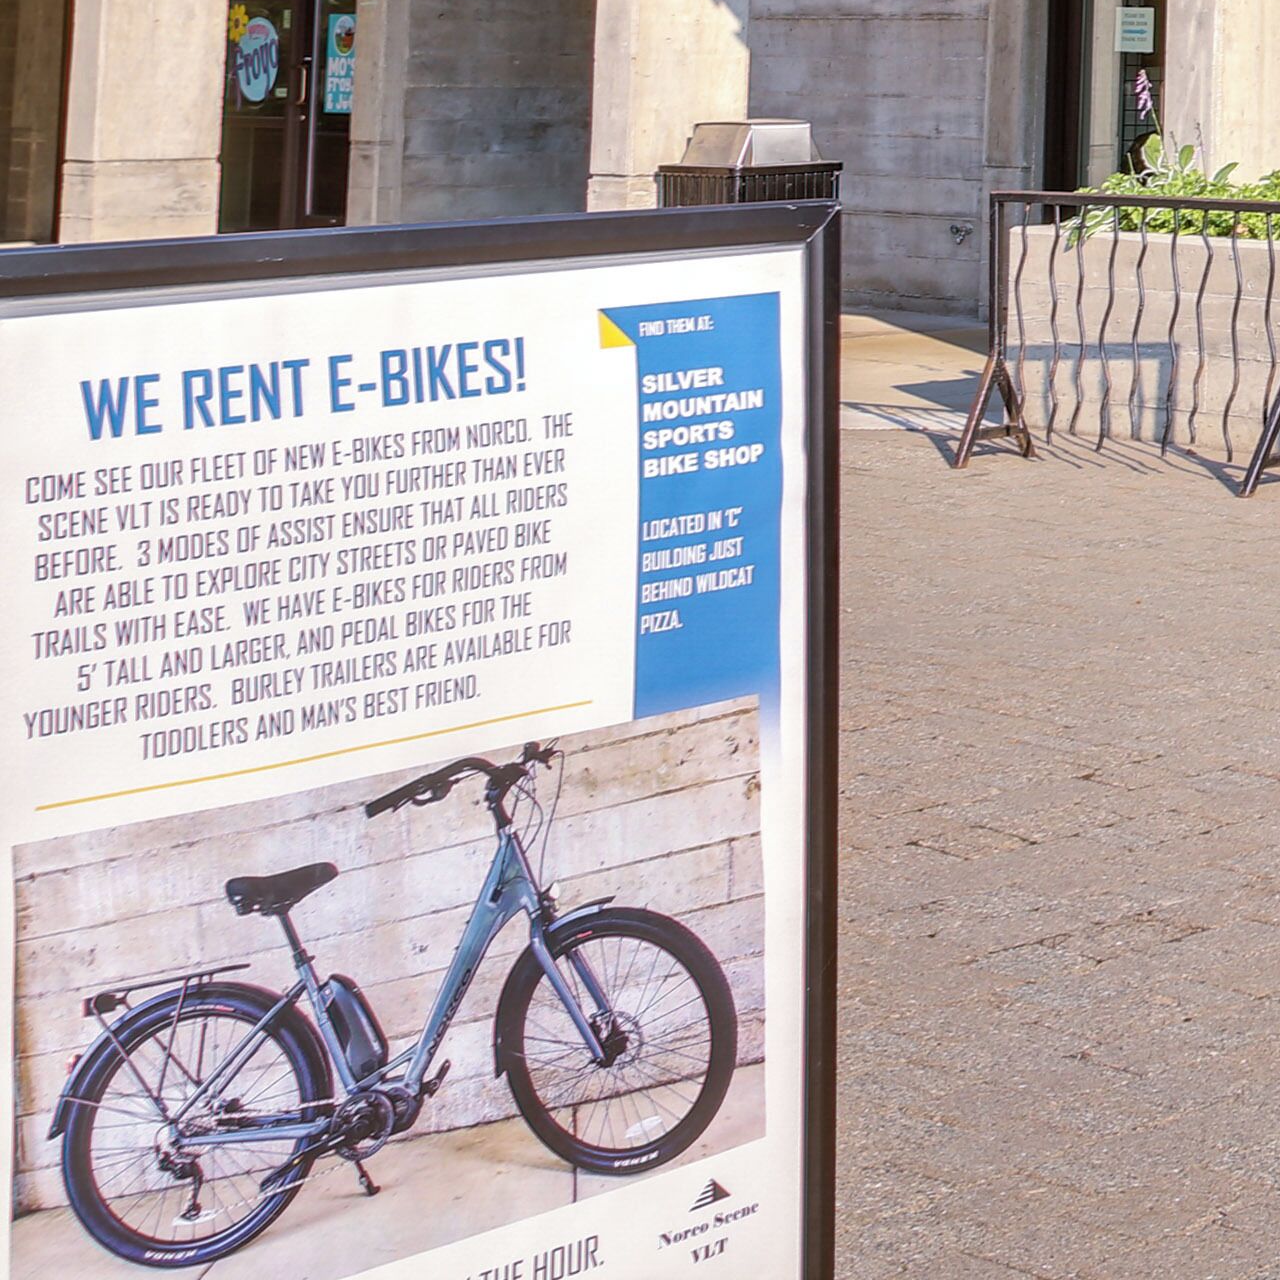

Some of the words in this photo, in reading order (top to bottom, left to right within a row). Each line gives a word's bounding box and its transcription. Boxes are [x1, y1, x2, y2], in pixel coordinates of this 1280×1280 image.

[639, 320, 664, 337] FIND
[666, 317, 696, 334] THEM
[696, 315, 715, 331] AT:
[79, 373, 163, 441] WE
[181, 358, 310, 430] RENT
[328, 336, 526, 413] E-BIKES!
[642, 366, 725, 394] SILVER
[643, 389, 764, 422] MOUNTAIN
[642, 421, 736, 450] SPORTS
[25, 470, 87, 505] COME
[94, 465, 133, 497] SEE
[139, 459, 183, 491] OUR
[190, 451, 247, 484] FLEET
[253, 447, 278, 477] OF
[284, 442, 326, 473] NEW
[331, 432, 405, 467] E-BIKES
[411, 426, 461, 457] FROM
[465, 418, 532, 450] NORCO.
[541, 412, 574, 440] THE
[643, 452, 699, 478] BIKE
[703, 443, 765, 469] SHOP
[38, 506, 109, 543] SCENE
[115, 501, 153, 532] VLT
[159, 497, 180, 526] IS
[186, 488, 252, 523] READY
[257, 484, 283, 513] TO
[288, 477, 335, 509] TAKE
[340, 472, 380, 502] YOU
[385, 460, 467, 496] FURTHER
[471, 454, 518, 484] THAN
[523, 448, 565, 477] EVER
[34, 544, 123, 582] BEFORE.
[137, 539, 151, 568] 3
[157, 529, 230, 565] MODES
[236, 524, 261, 554] OF
[266, 513, 336, 550] ASSIST
[342, 503, 414, 539] ENSURE
[419, 496, 465, 527] THAT
[469, 492, 501, 520] ALL
[506, 482, 568, 515] RIDERS
[642, 513, 705, 541] LOCATED
[708, 510, 723, 531] IN
[53, 585, 96, 619] ARE
[102, 577, 155, 611] ABLE
[161, 572, 188, 602] TO
[195, 558, 282, 598] EXPLORE
[288, 551, 331, 583] CITY
[336, 539, 417, 576] STREETS
[422, 534, 447, 563] OR
[452, 525, 509, 558] PAVED
[514, 519, 552, 549] BIKE
[642, 544, 707, 572] BUILDING
[709, 537, 744, 561] JUST
[31, 622, 107, 660] TRAILS
[114, 613, 166, 647] WITH
[174, 605, 231, 639] EASE.
[242, 597, 271, 627] WE
[277, 588, 326, 622] HAVE
[332, 577, 406, 613] E-BIKES
[412, 570, 447, 601] FOR
[452, 559, 515, 594] RIDERS
[520, 551, 567, 582] FROM
[641, 576, 693, 604] BEHIND
[696, 565, 755, 594] WILDCAT
[77, 663, 97, 693] 5'
[103, 655, 153, 688] TALL
[159, 646, 203, 679] AND
[210, 632, 291, 671] LARGER,
[296, 624, 335, 657] AND
[341, 614, 400, 648] PEDAL
[405, 604, 456, 638] BIKES
[462, 597, 495, 628] FOR
[500, 591, 532, 620] THE
[640, 609, 684, 634] PIZZA.
[22, 696, 128, 740] YOUNGER
[135, 683, 218, 722] RIDERS.
[231, 666, 305, 706] BURLEY
[309, 650, 397, 690] TRAILERS
[402, 643, 438, 674] ARE
[443, 626, 533, 667] AVAILABLE
[538, 619, 572, 649] FOR
[139, 716, 249, 761] TODDLERS
[255, 708, 295, 741] AND
[300, 695, 357, 732] MAN'S
[363, 686, 410, 720] BEST
[415, 674, 481, 710] FRIEND.
[657, 1222, 709, 1250] Norco
[713, 1203, 760, 1228] Scene
[531, 1235, 605, 1280] HOUR.
[690, 1237, 729, 1264] VLT
